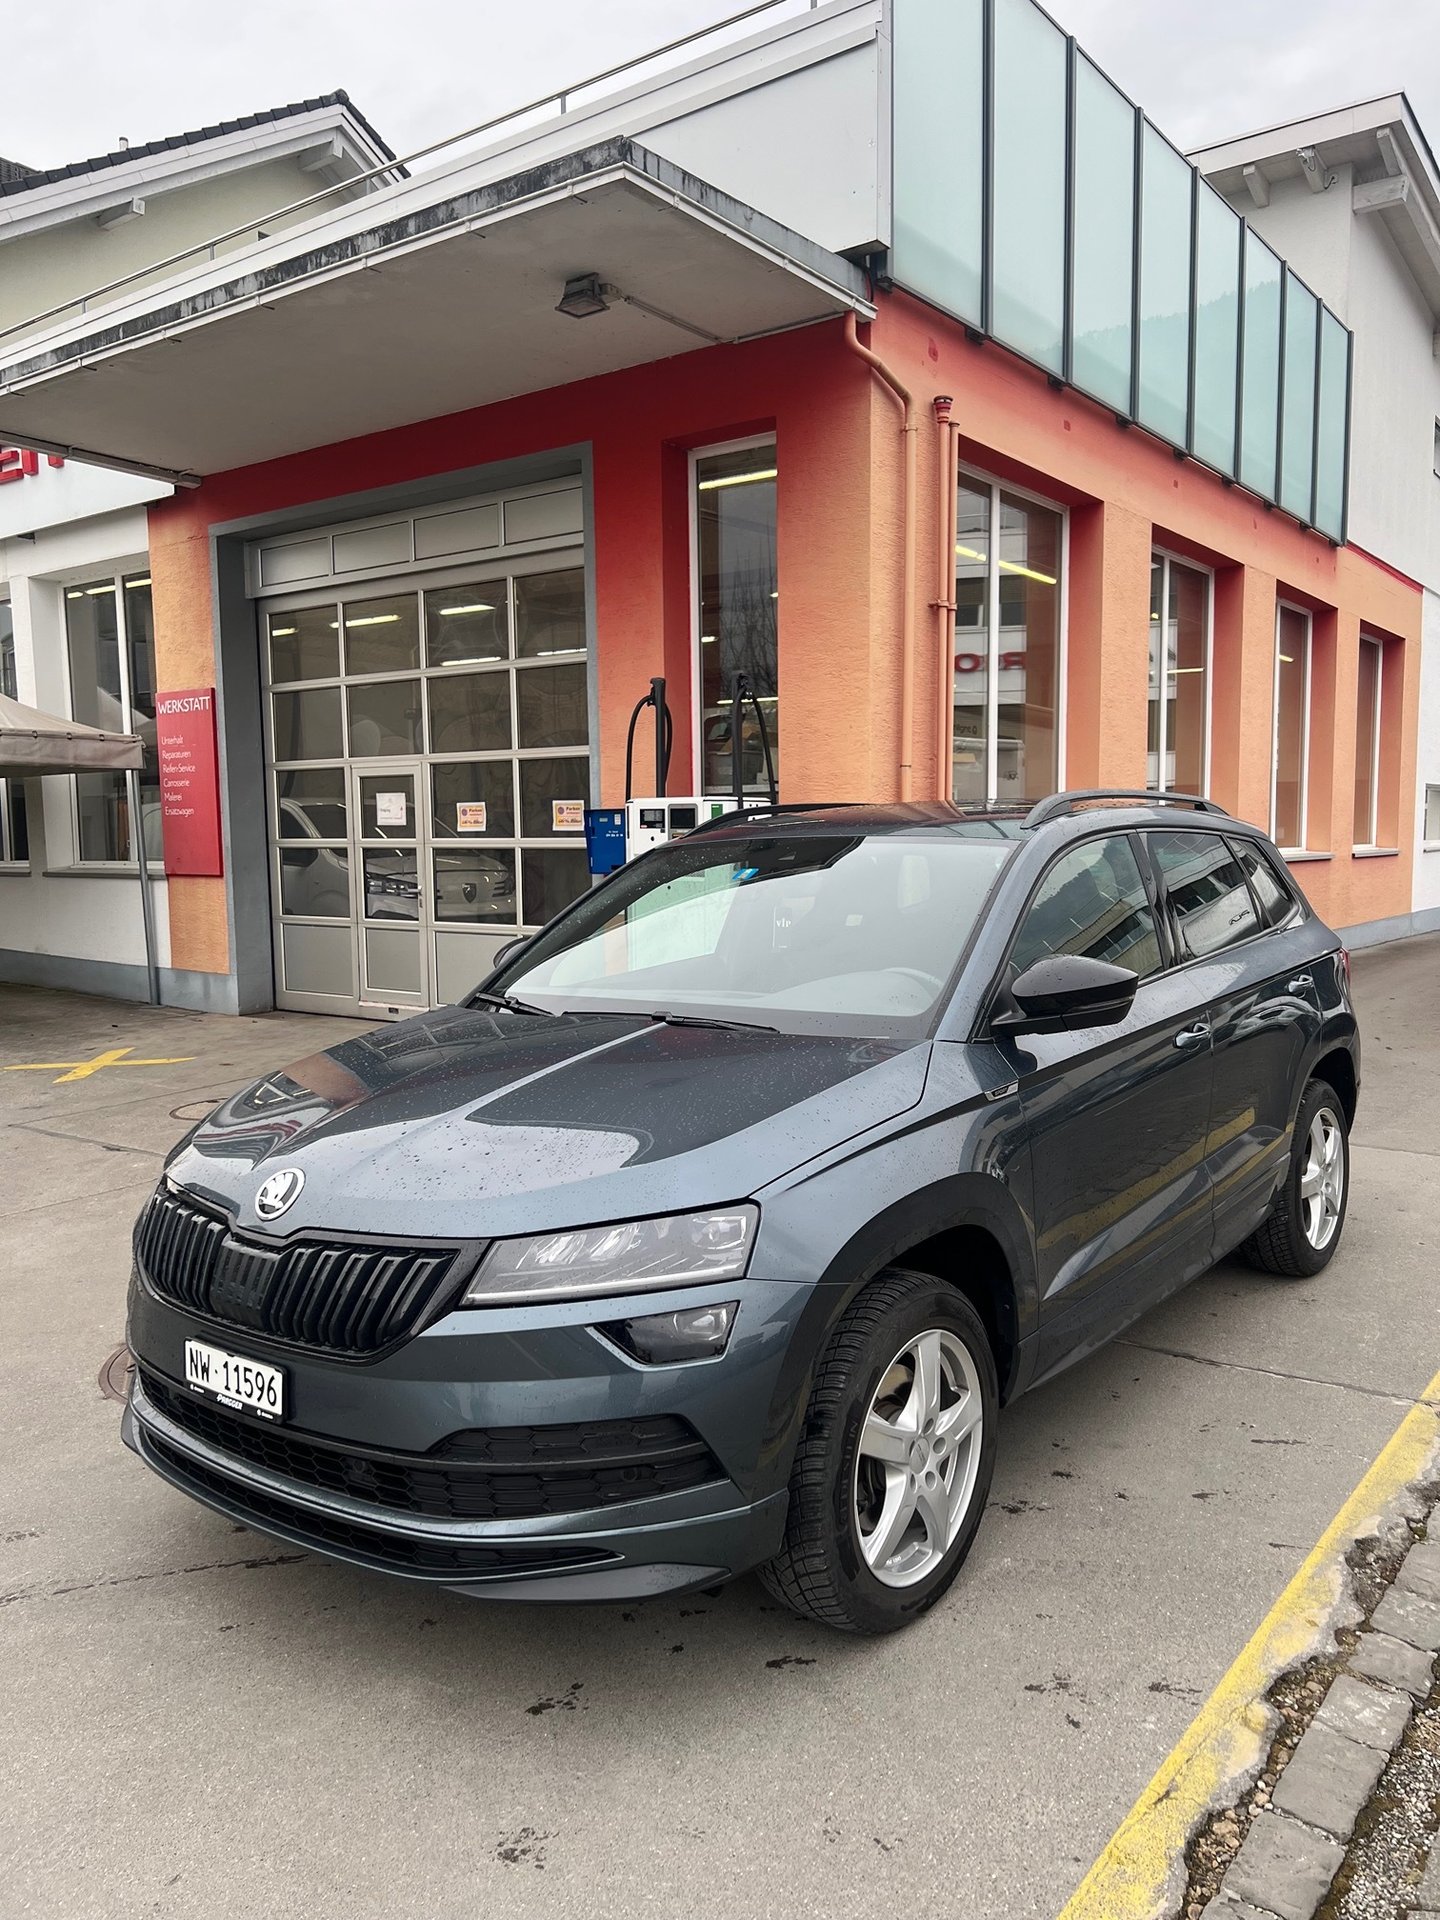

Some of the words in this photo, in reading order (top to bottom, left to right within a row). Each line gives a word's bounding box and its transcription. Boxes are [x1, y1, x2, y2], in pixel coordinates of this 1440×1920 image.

[157, 696, 211, 715] WERKSTATT
[161, 734, 184, 746] Unterhalt
[162, 749, 192, 761] Reparaturen
[164, 792, 183, 802] Malerei
